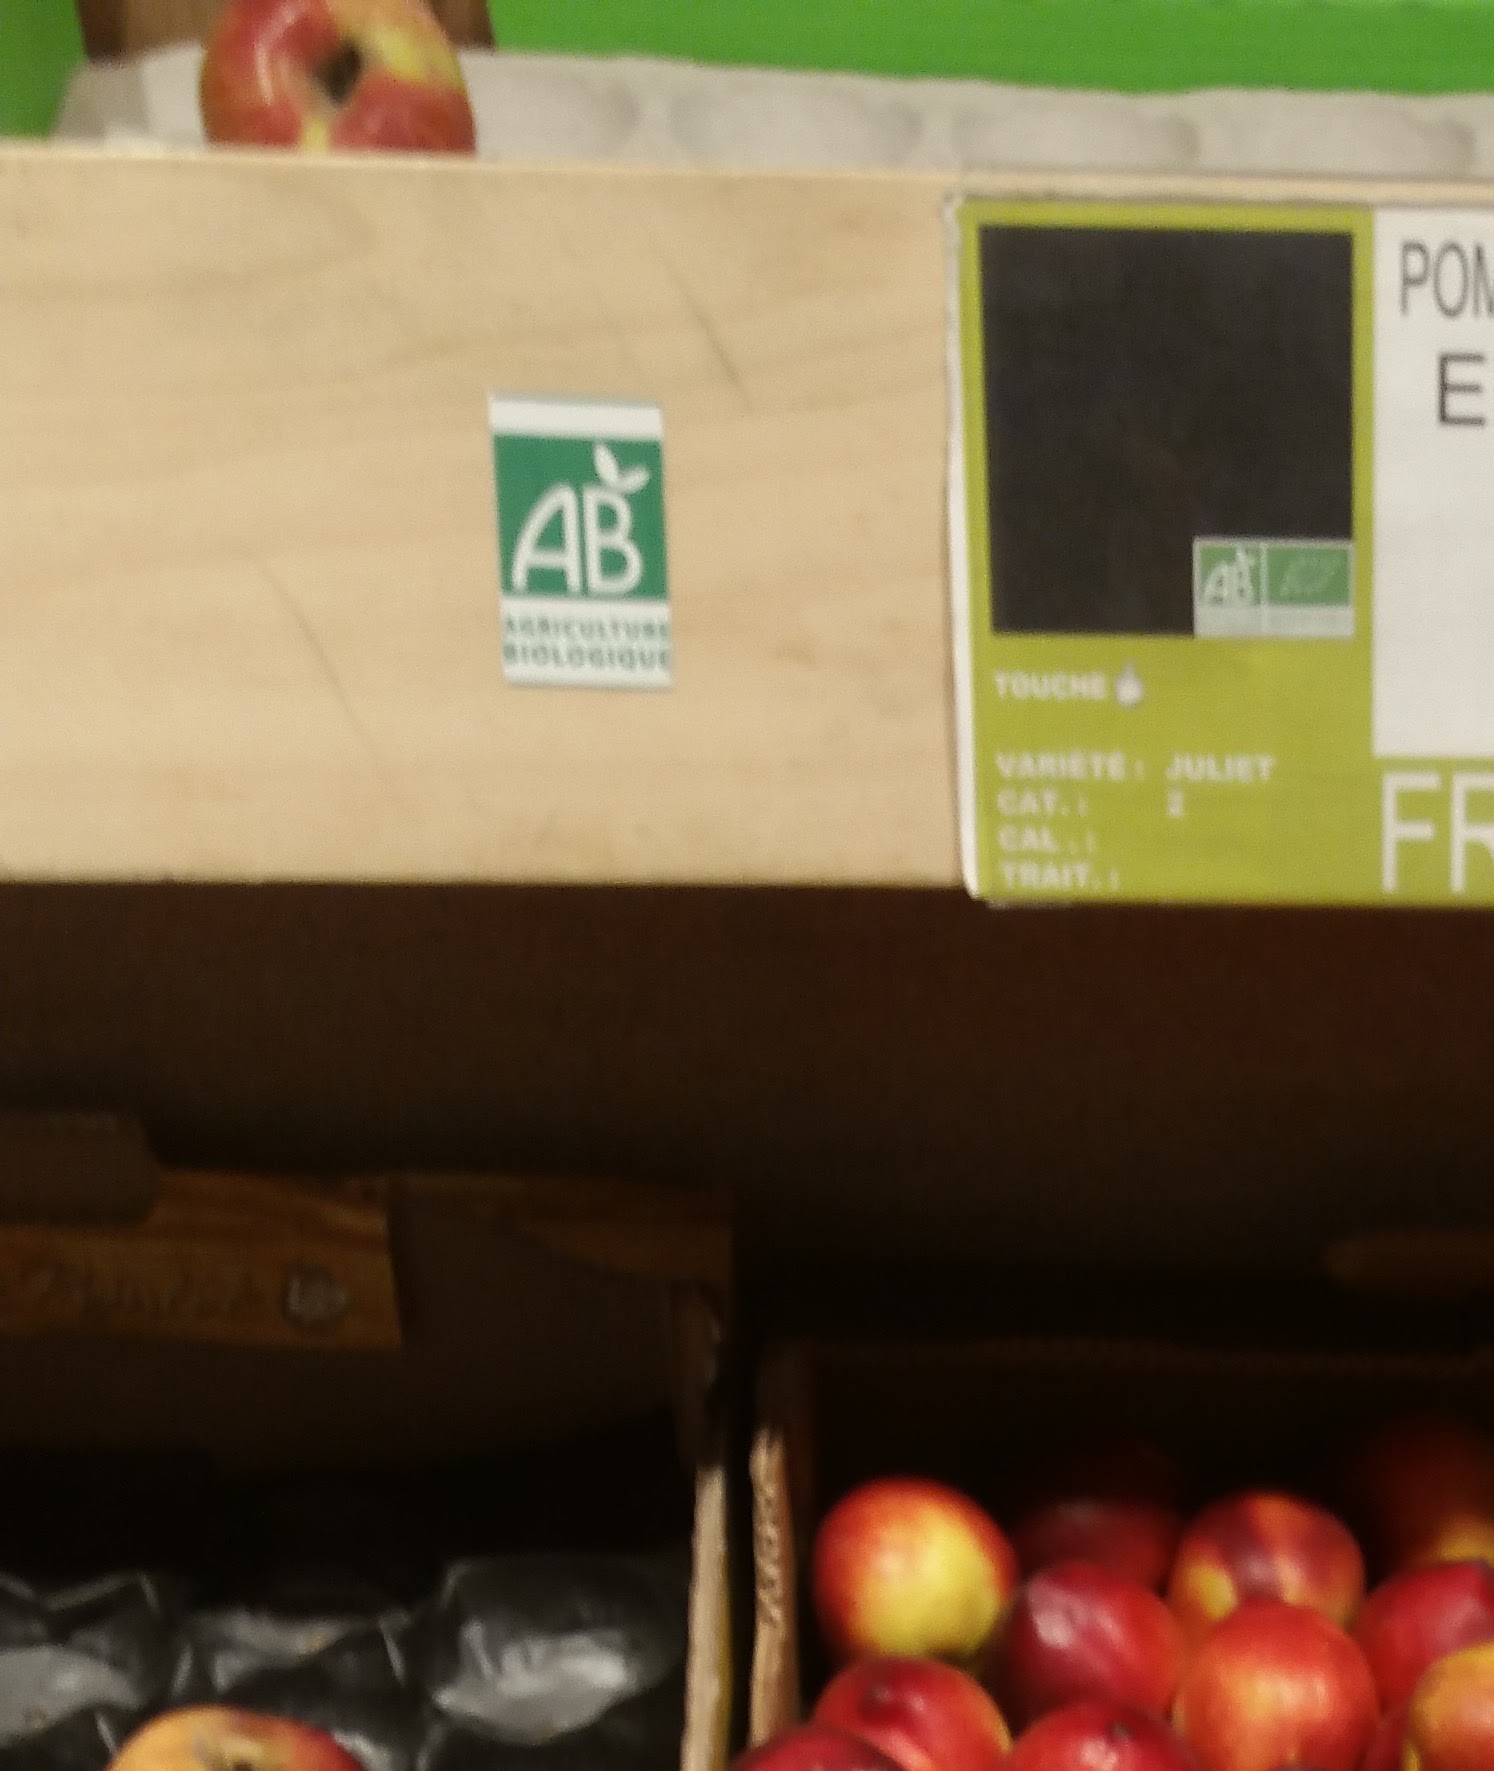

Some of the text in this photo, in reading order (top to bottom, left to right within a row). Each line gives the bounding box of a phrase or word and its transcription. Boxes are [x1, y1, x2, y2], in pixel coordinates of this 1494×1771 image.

[512, 481, 642, 595] AB
[995, 670, 1107, 700] TOUCHE
[1164, 751, 1276, 782] JULIET
